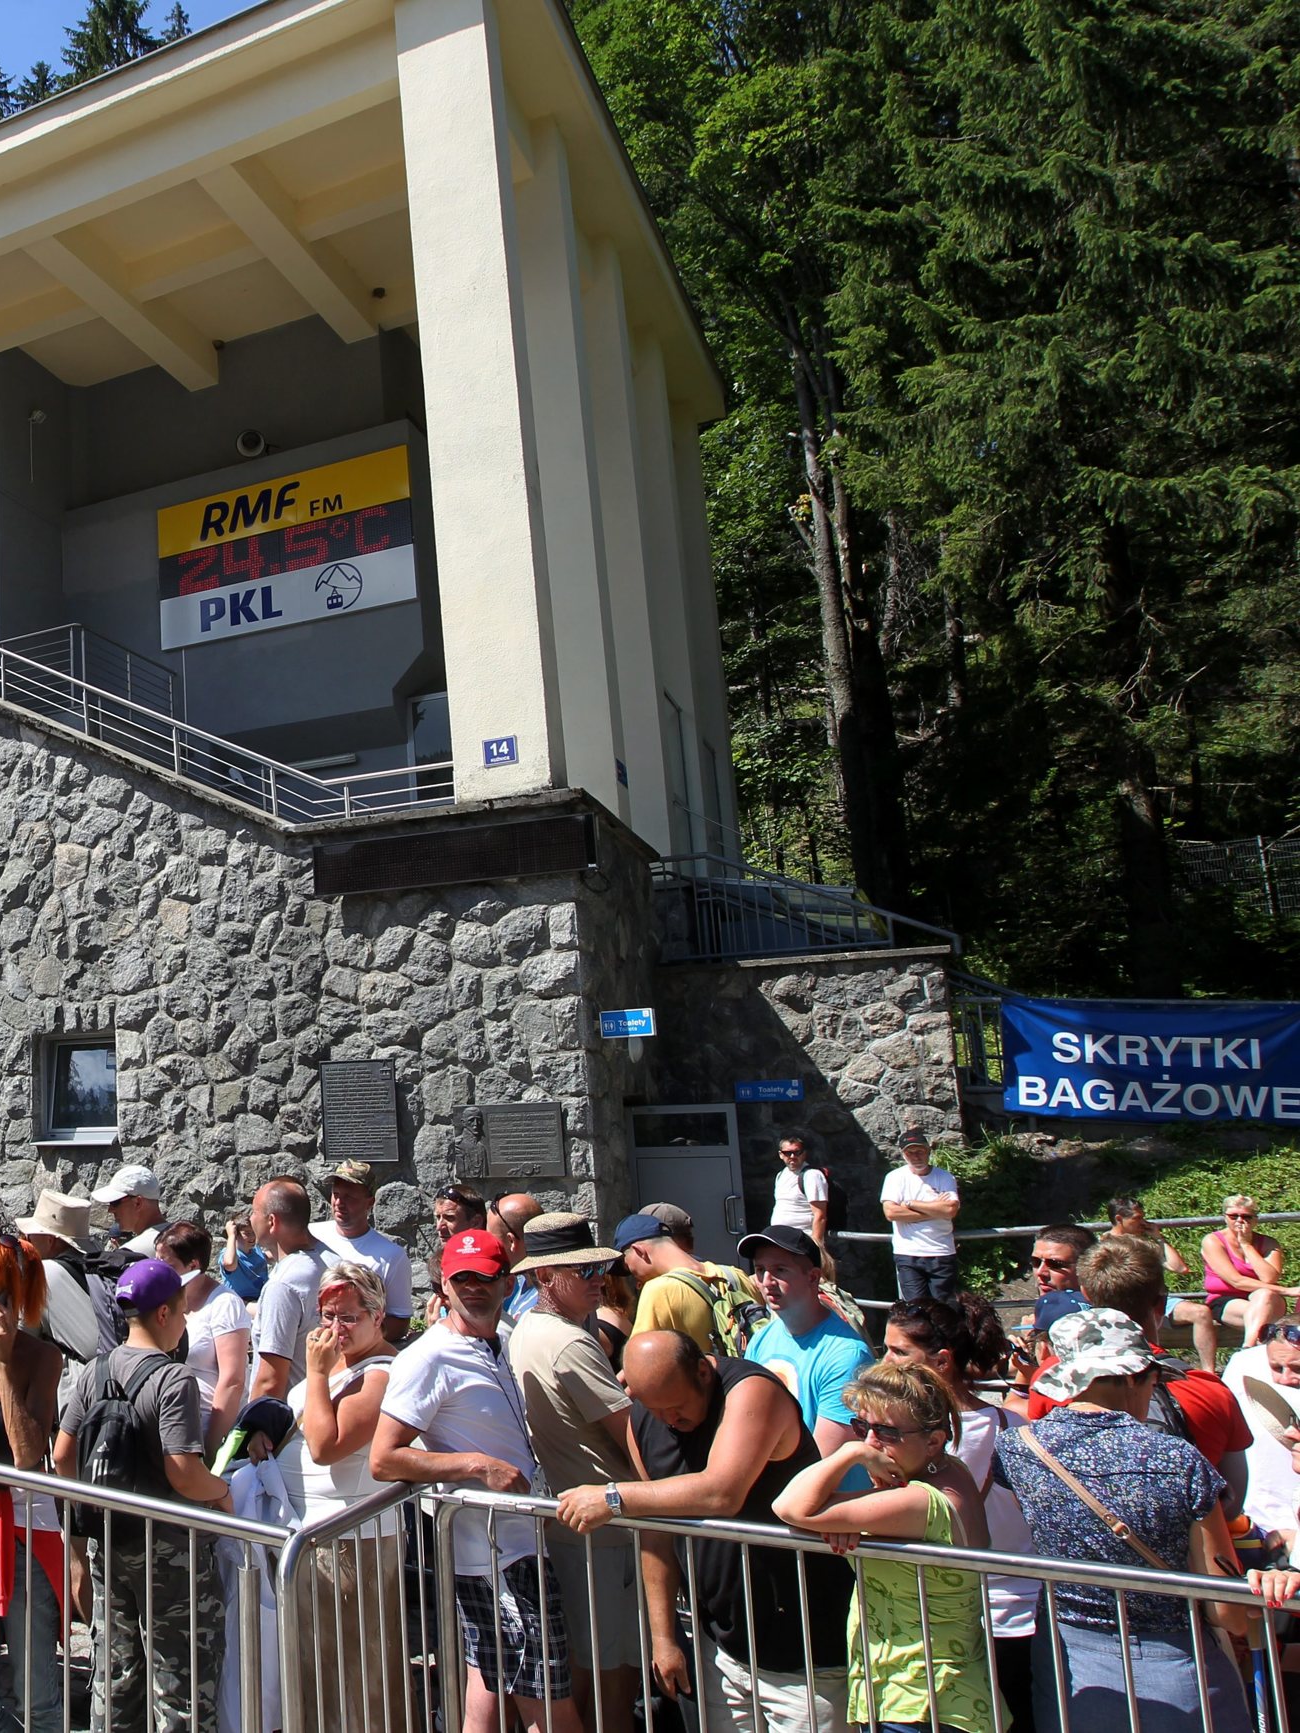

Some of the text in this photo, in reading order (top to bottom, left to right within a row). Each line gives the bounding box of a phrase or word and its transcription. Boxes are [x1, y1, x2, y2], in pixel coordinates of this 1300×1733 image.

[200, 481, 343, 541] RMF FM
[177, 505, 390, 596] 24.5°C
[200, 585, 283, 633] PKL
[490, 741, 509, 756] 14
[618, 1019, 646, 1028] Toalety
[1052, 1032, 1261, 1070] SKRYTKI
[758, 1086, 784, 1094] Toalety
[1018, 1074, 1300, 1119] BAGAŻOWE
